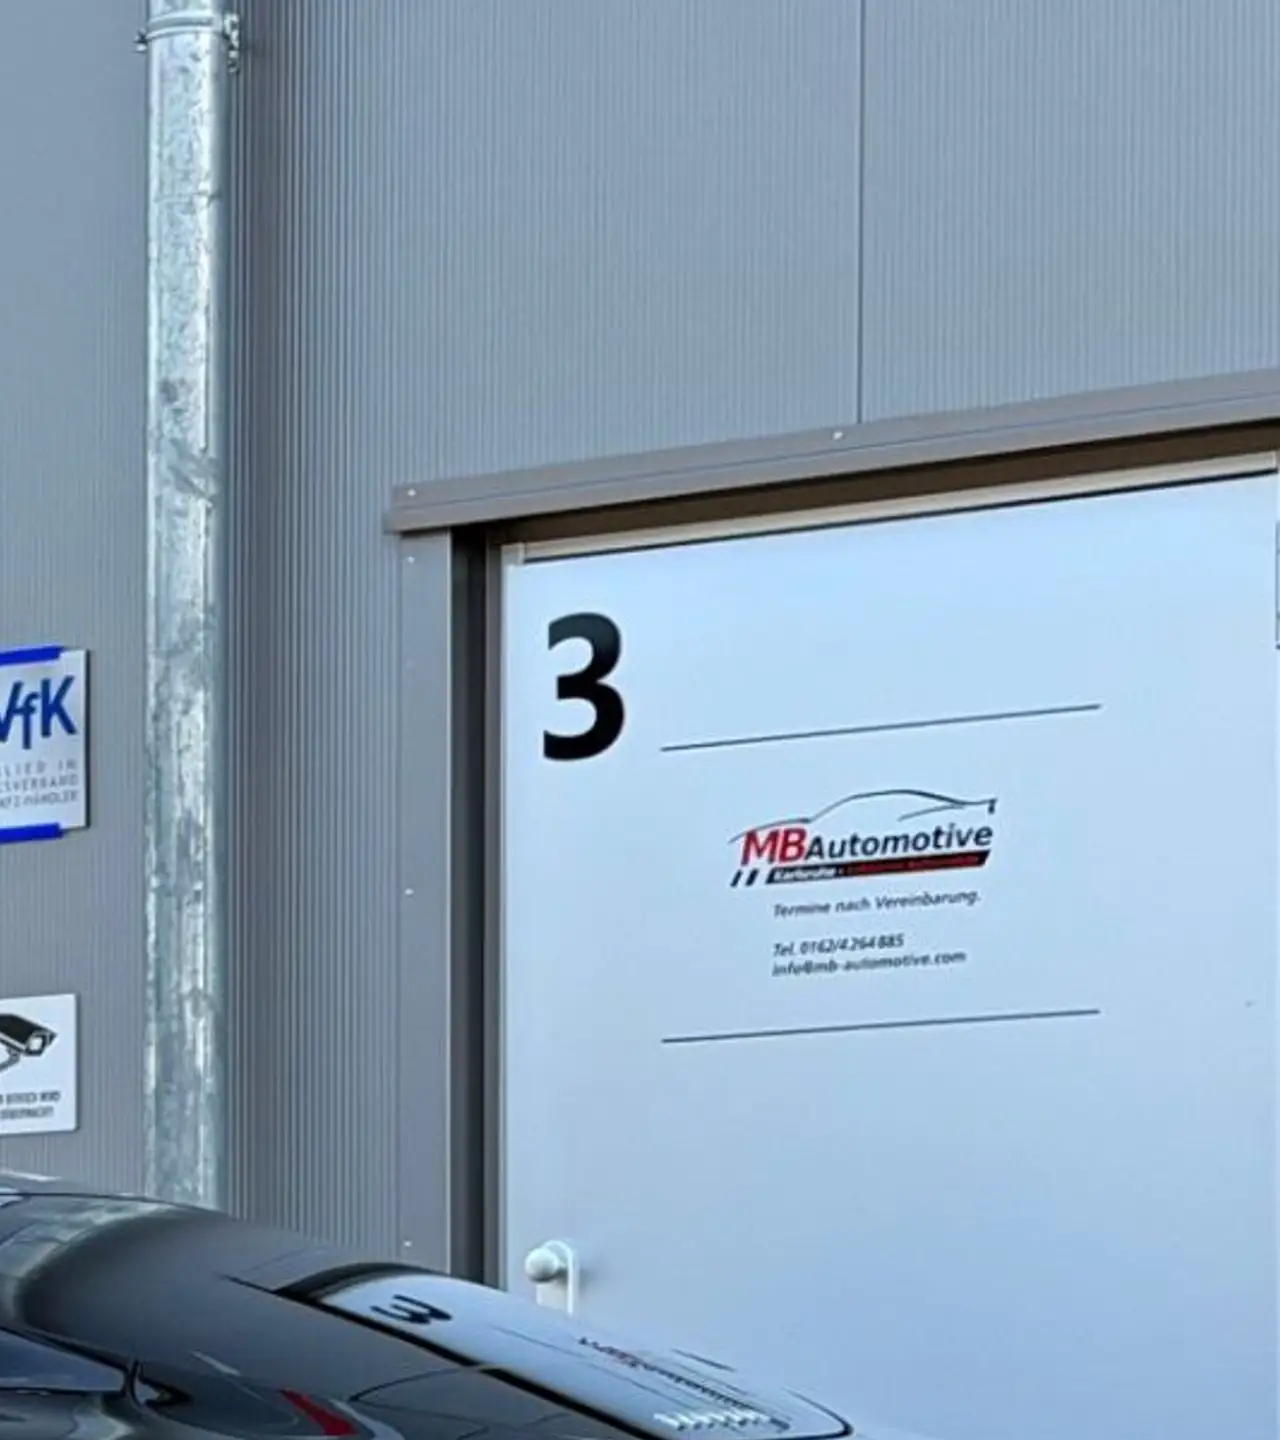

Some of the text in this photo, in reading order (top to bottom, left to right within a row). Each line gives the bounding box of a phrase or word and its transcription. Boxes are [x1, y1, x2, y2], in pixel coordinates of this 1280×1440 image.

[543, 612, 625, 761] 3
[774, 902, 831, 917] Termine
[835, 898, 870, 913] nach
